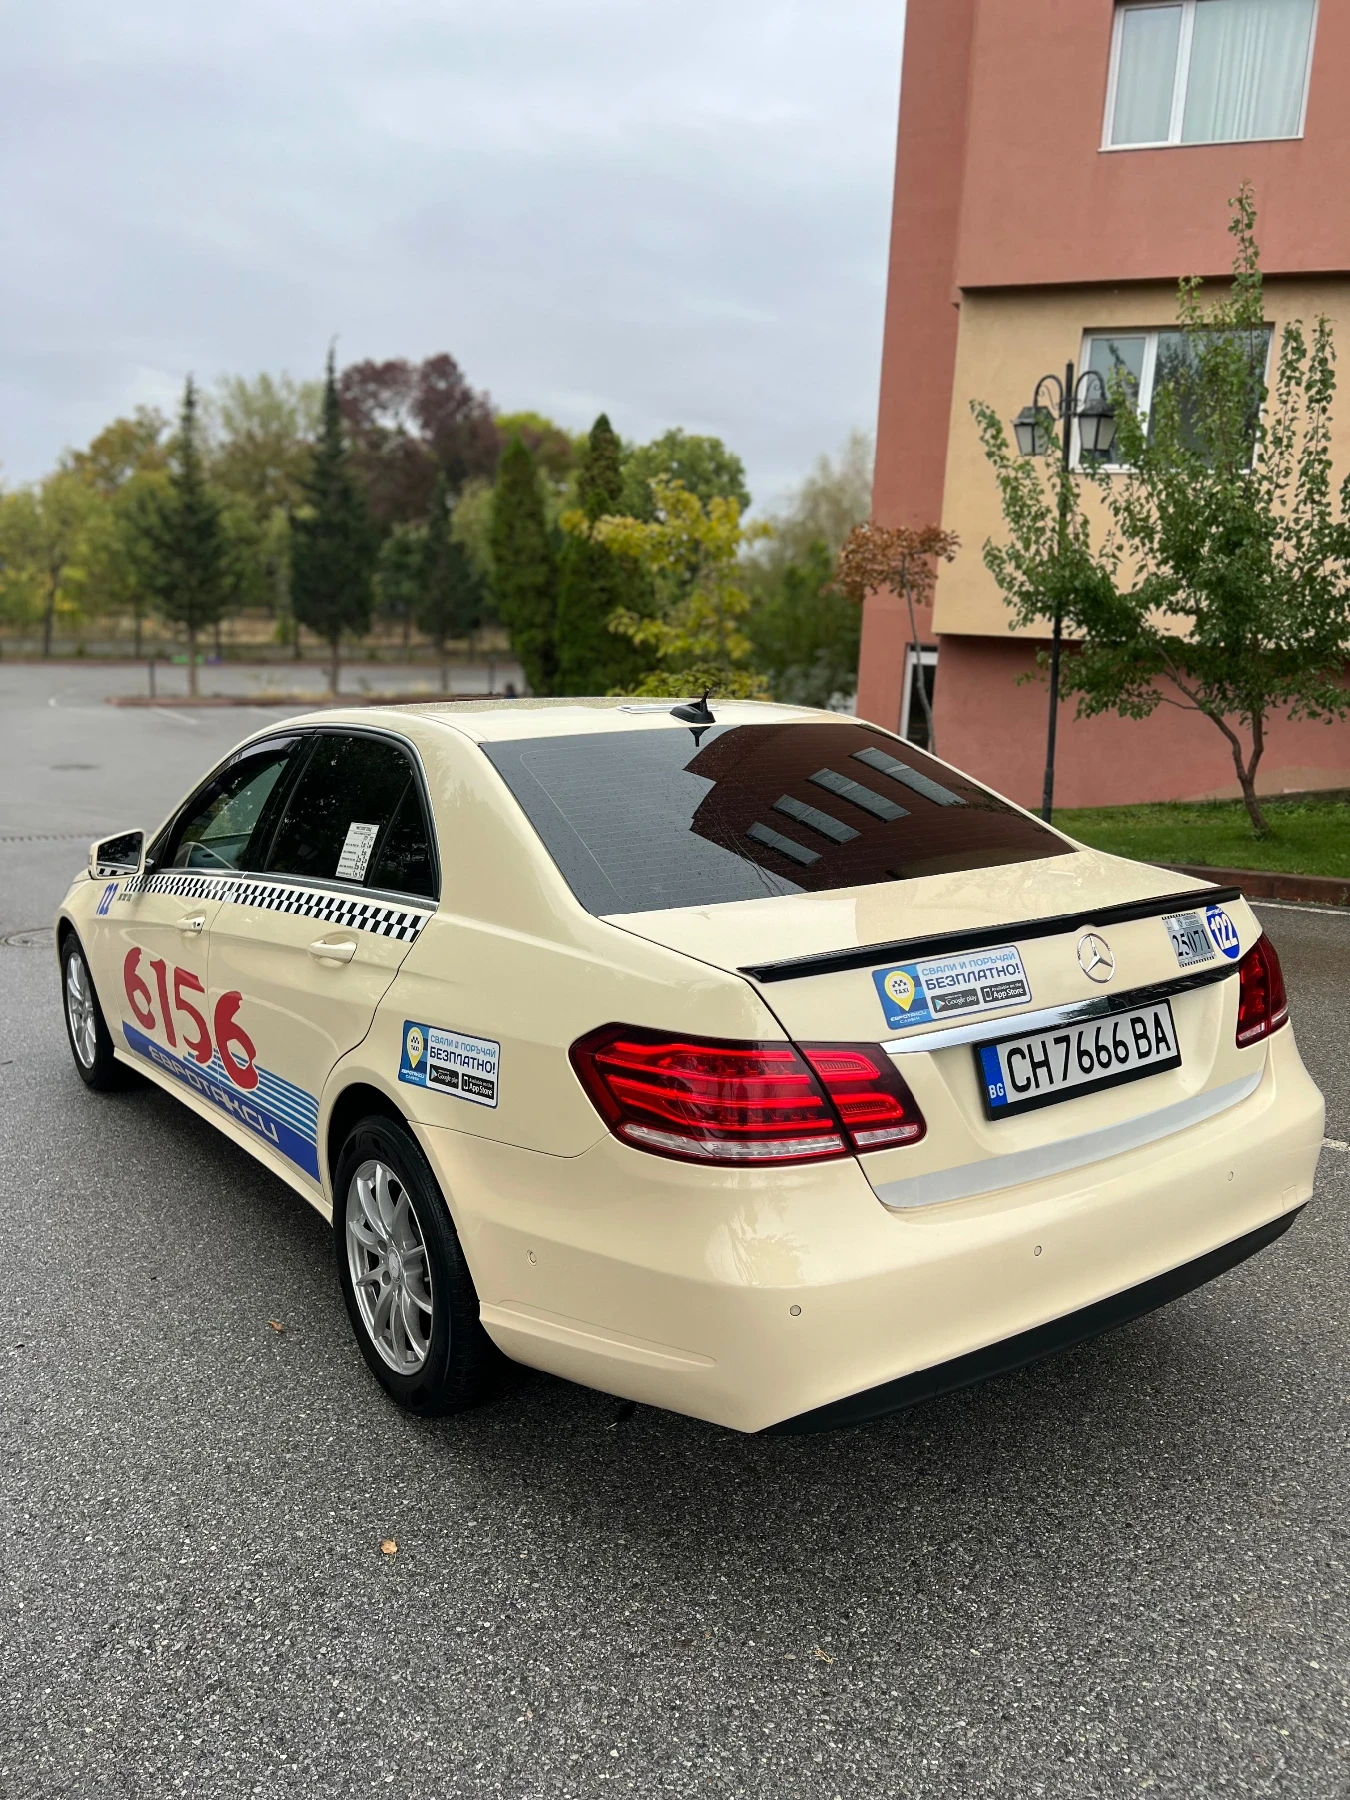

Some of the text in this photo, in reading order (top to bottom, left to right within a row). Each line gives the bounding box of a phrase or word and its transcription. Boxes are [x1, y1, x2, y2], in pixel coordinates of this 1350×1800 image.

[1172, 929, 1211, 957] 25071
[1210, 913, 1239, 950] 122
[921, 951, 1016, 976] СВАЛИ И ПОРЪЧАЙ
[924, 962, 1021, 990] БЕЗПЛАТНО!
[945, 996, 966, 1006] Google
[966, 994, 977, 1003] play
[993, 987, 1024, 999] App Store
[123, 946, 260, 1090] 6156
[430, 1034, 453, 1045] СВАЛИ
[460, 1042, 496, 1058] ПОРЪЧАЙ
[430, 1046, 496, 1074] БЕЗПЛАТНО!
[148, 1045, 280, 1143] ЕВРОТАКСИ
[469, 1082, 493, 1096] App Store
[988, 1083, 1004, 1099] BG
